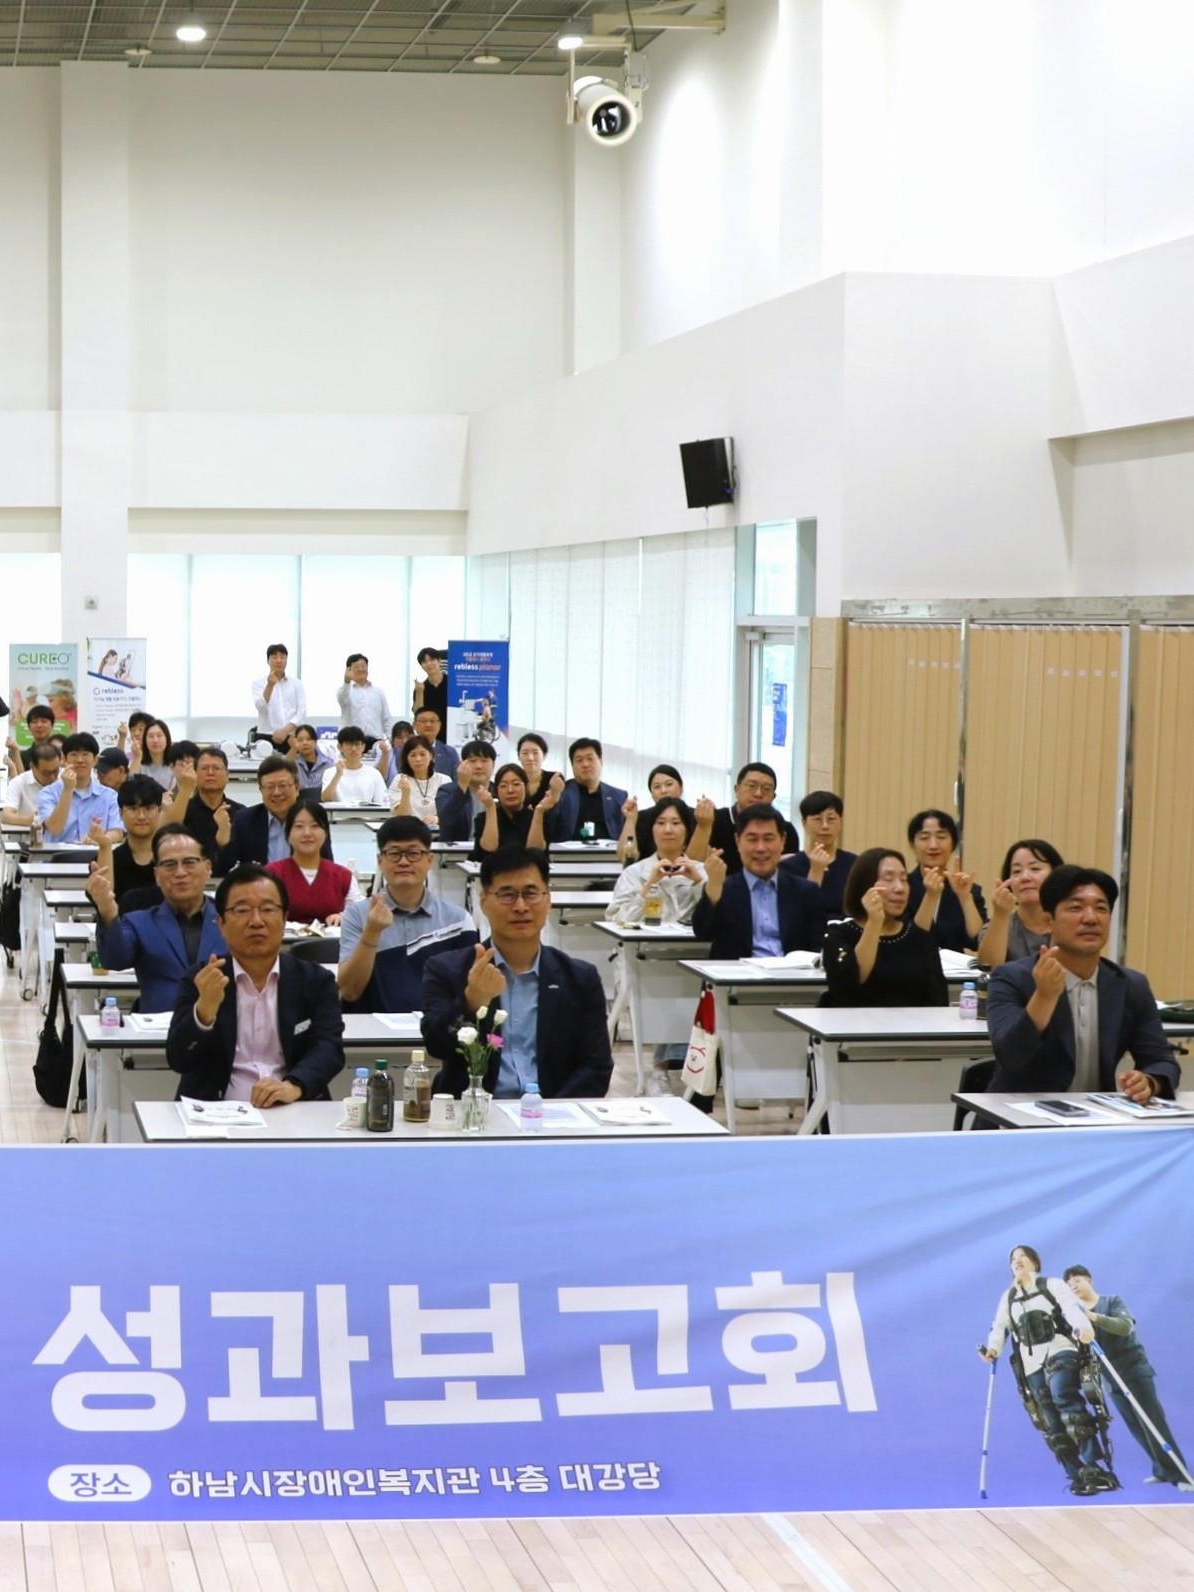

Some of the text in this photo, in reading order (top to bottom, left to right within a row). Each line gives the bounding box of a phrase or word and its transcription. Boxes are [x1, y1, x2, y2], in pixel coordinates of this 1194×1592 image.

[17, 652, 70, 665] CUREO
[32, 1270, 879, 1432] 성과보고회
[70, 1461, 661, 1498] 장소 하남시장애인복지관 4층 대강당
